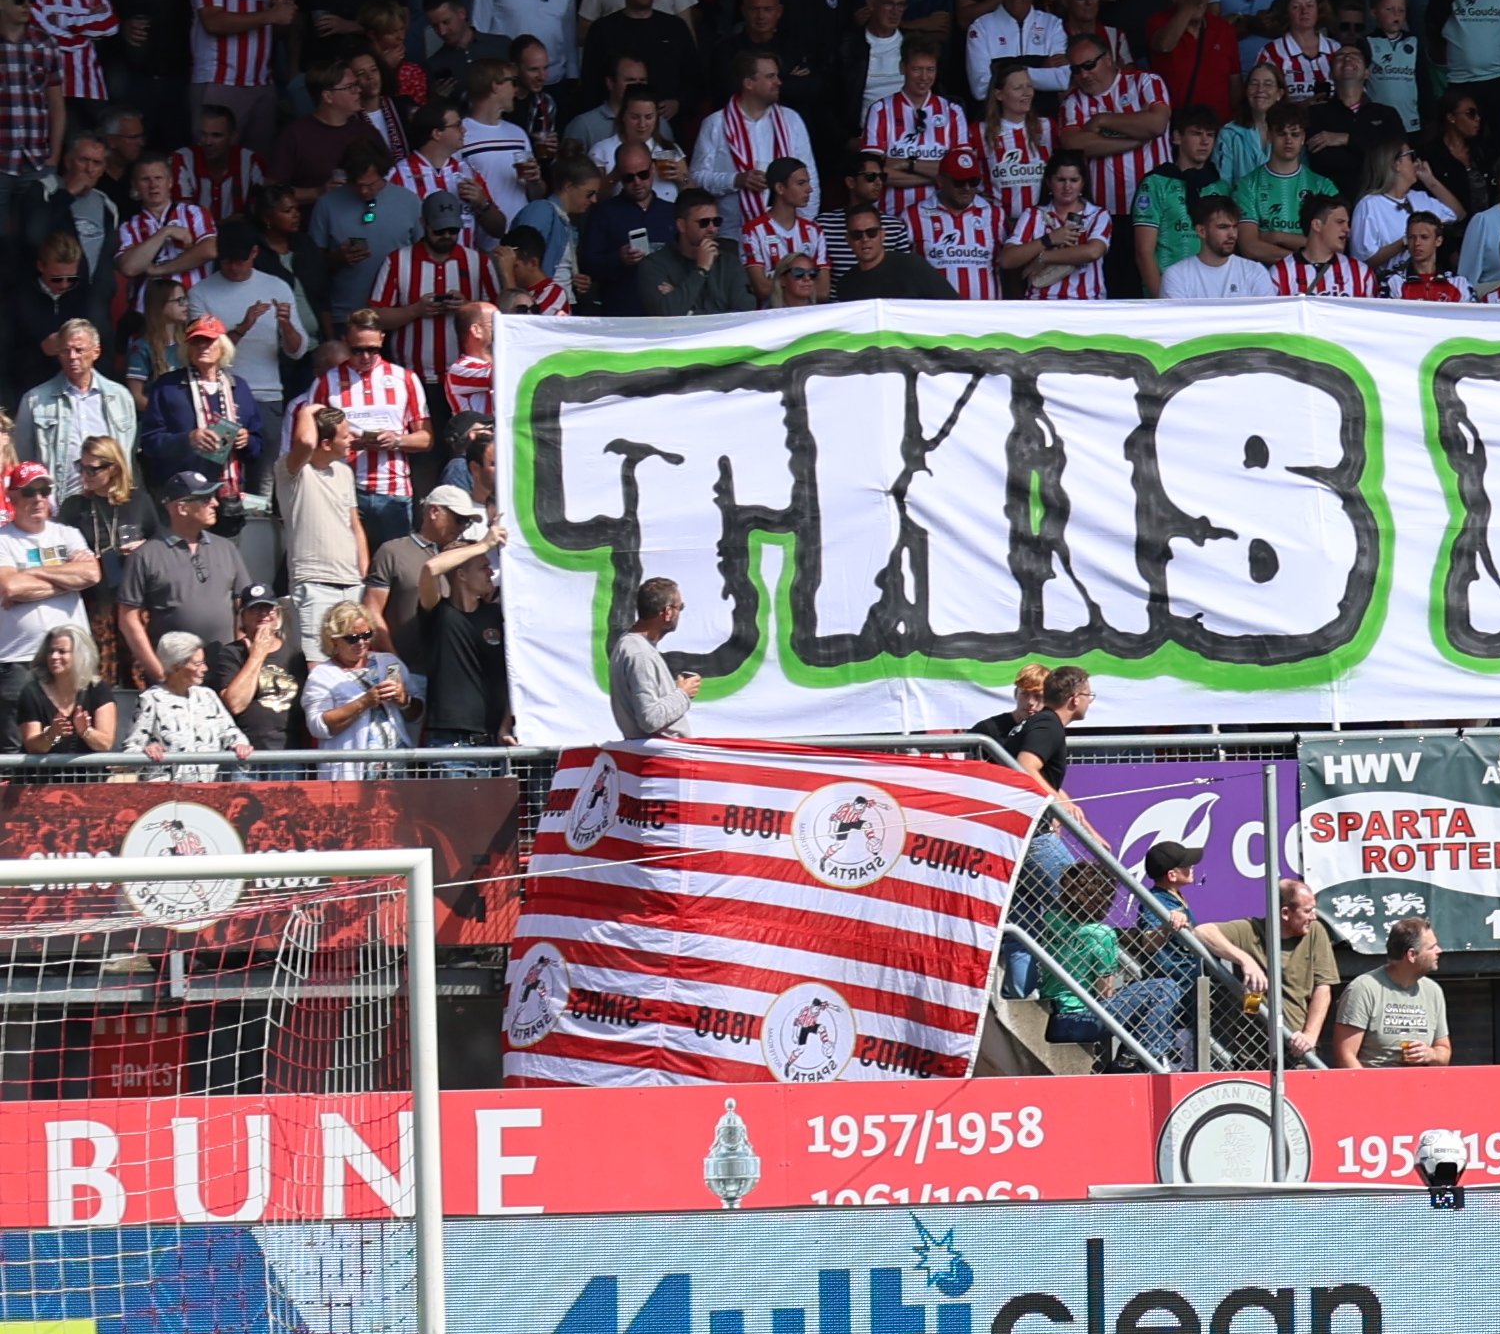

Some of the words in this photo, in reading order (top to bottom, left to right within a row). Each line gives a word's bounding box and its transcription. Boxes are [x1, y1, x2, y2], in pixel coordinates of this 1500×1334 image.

[1454, 5, 1466, 16] de
[904, 146, 949, 158] Goudse
[930, 245, 944, 257] de
[945, 245, 989, 257] Goudse
[1324, 752, 1422, 784] HWV
[1309, 807, 1477, 844] SPARTA
[807, 1106, 1044, 1163] 1957/1958
